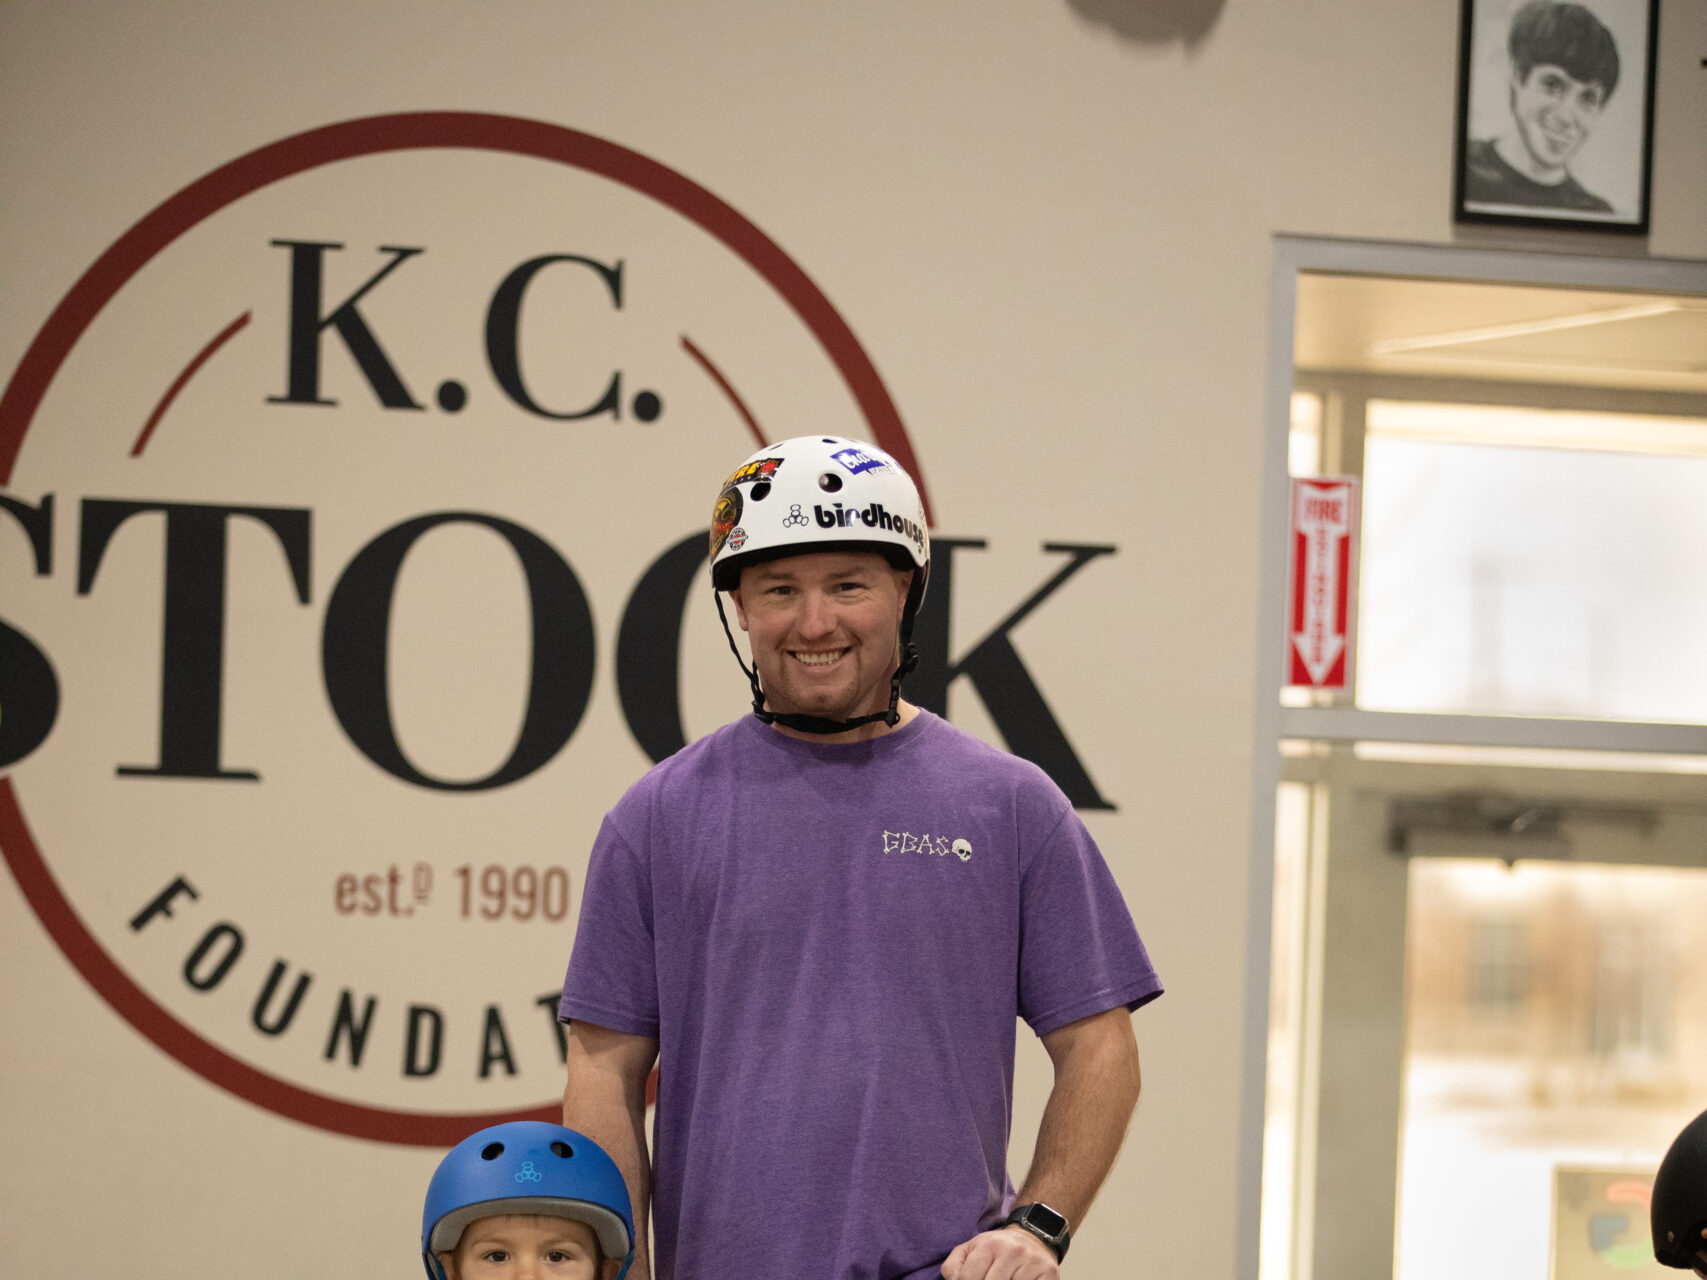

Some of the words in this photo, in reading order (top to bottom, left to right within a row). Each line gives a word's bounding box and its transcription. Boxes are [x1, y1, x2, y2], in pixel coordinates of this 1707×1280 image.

[265, 238, 664, 423] K.C.
[813, 502, 924, 549] birdhouse
[882, 829, 950, 856] GBAS
[455, 864, 570, 922] 1990
